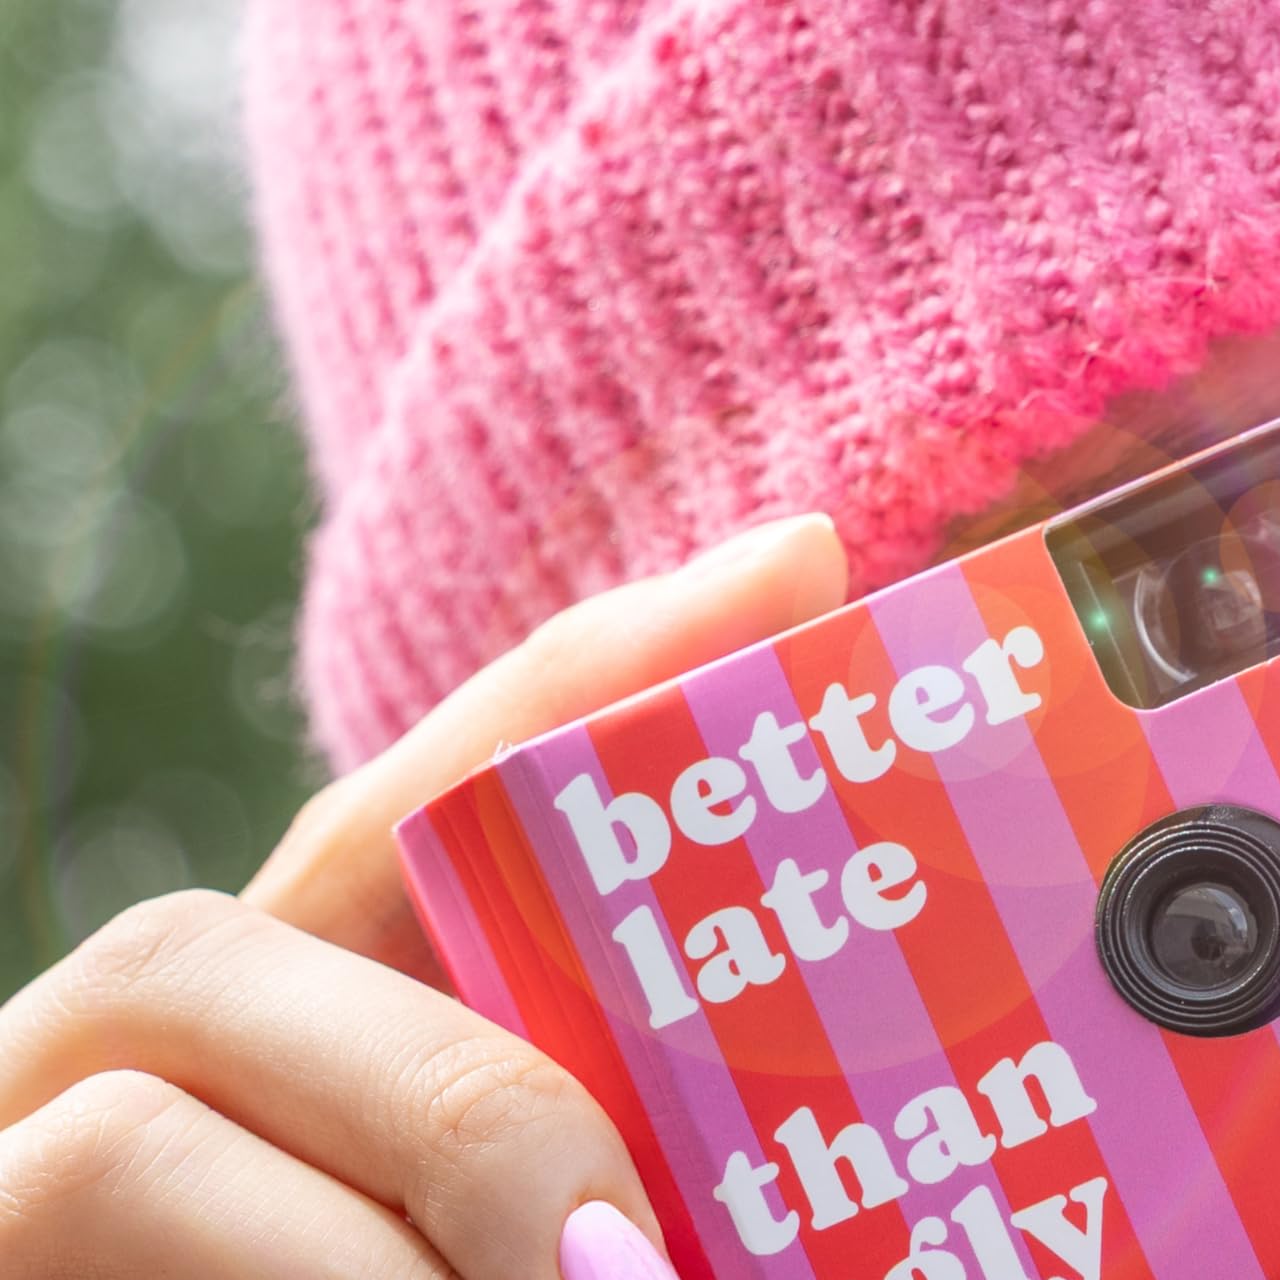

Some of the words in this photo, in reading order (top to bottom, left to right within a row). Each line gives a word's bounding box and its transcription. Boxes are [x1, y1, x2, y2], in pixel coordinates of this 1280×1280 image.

[554, 625, 1044, 897] better
[612, 841, 928, 1029] late
[714, 1040, 1098, 1256] than
